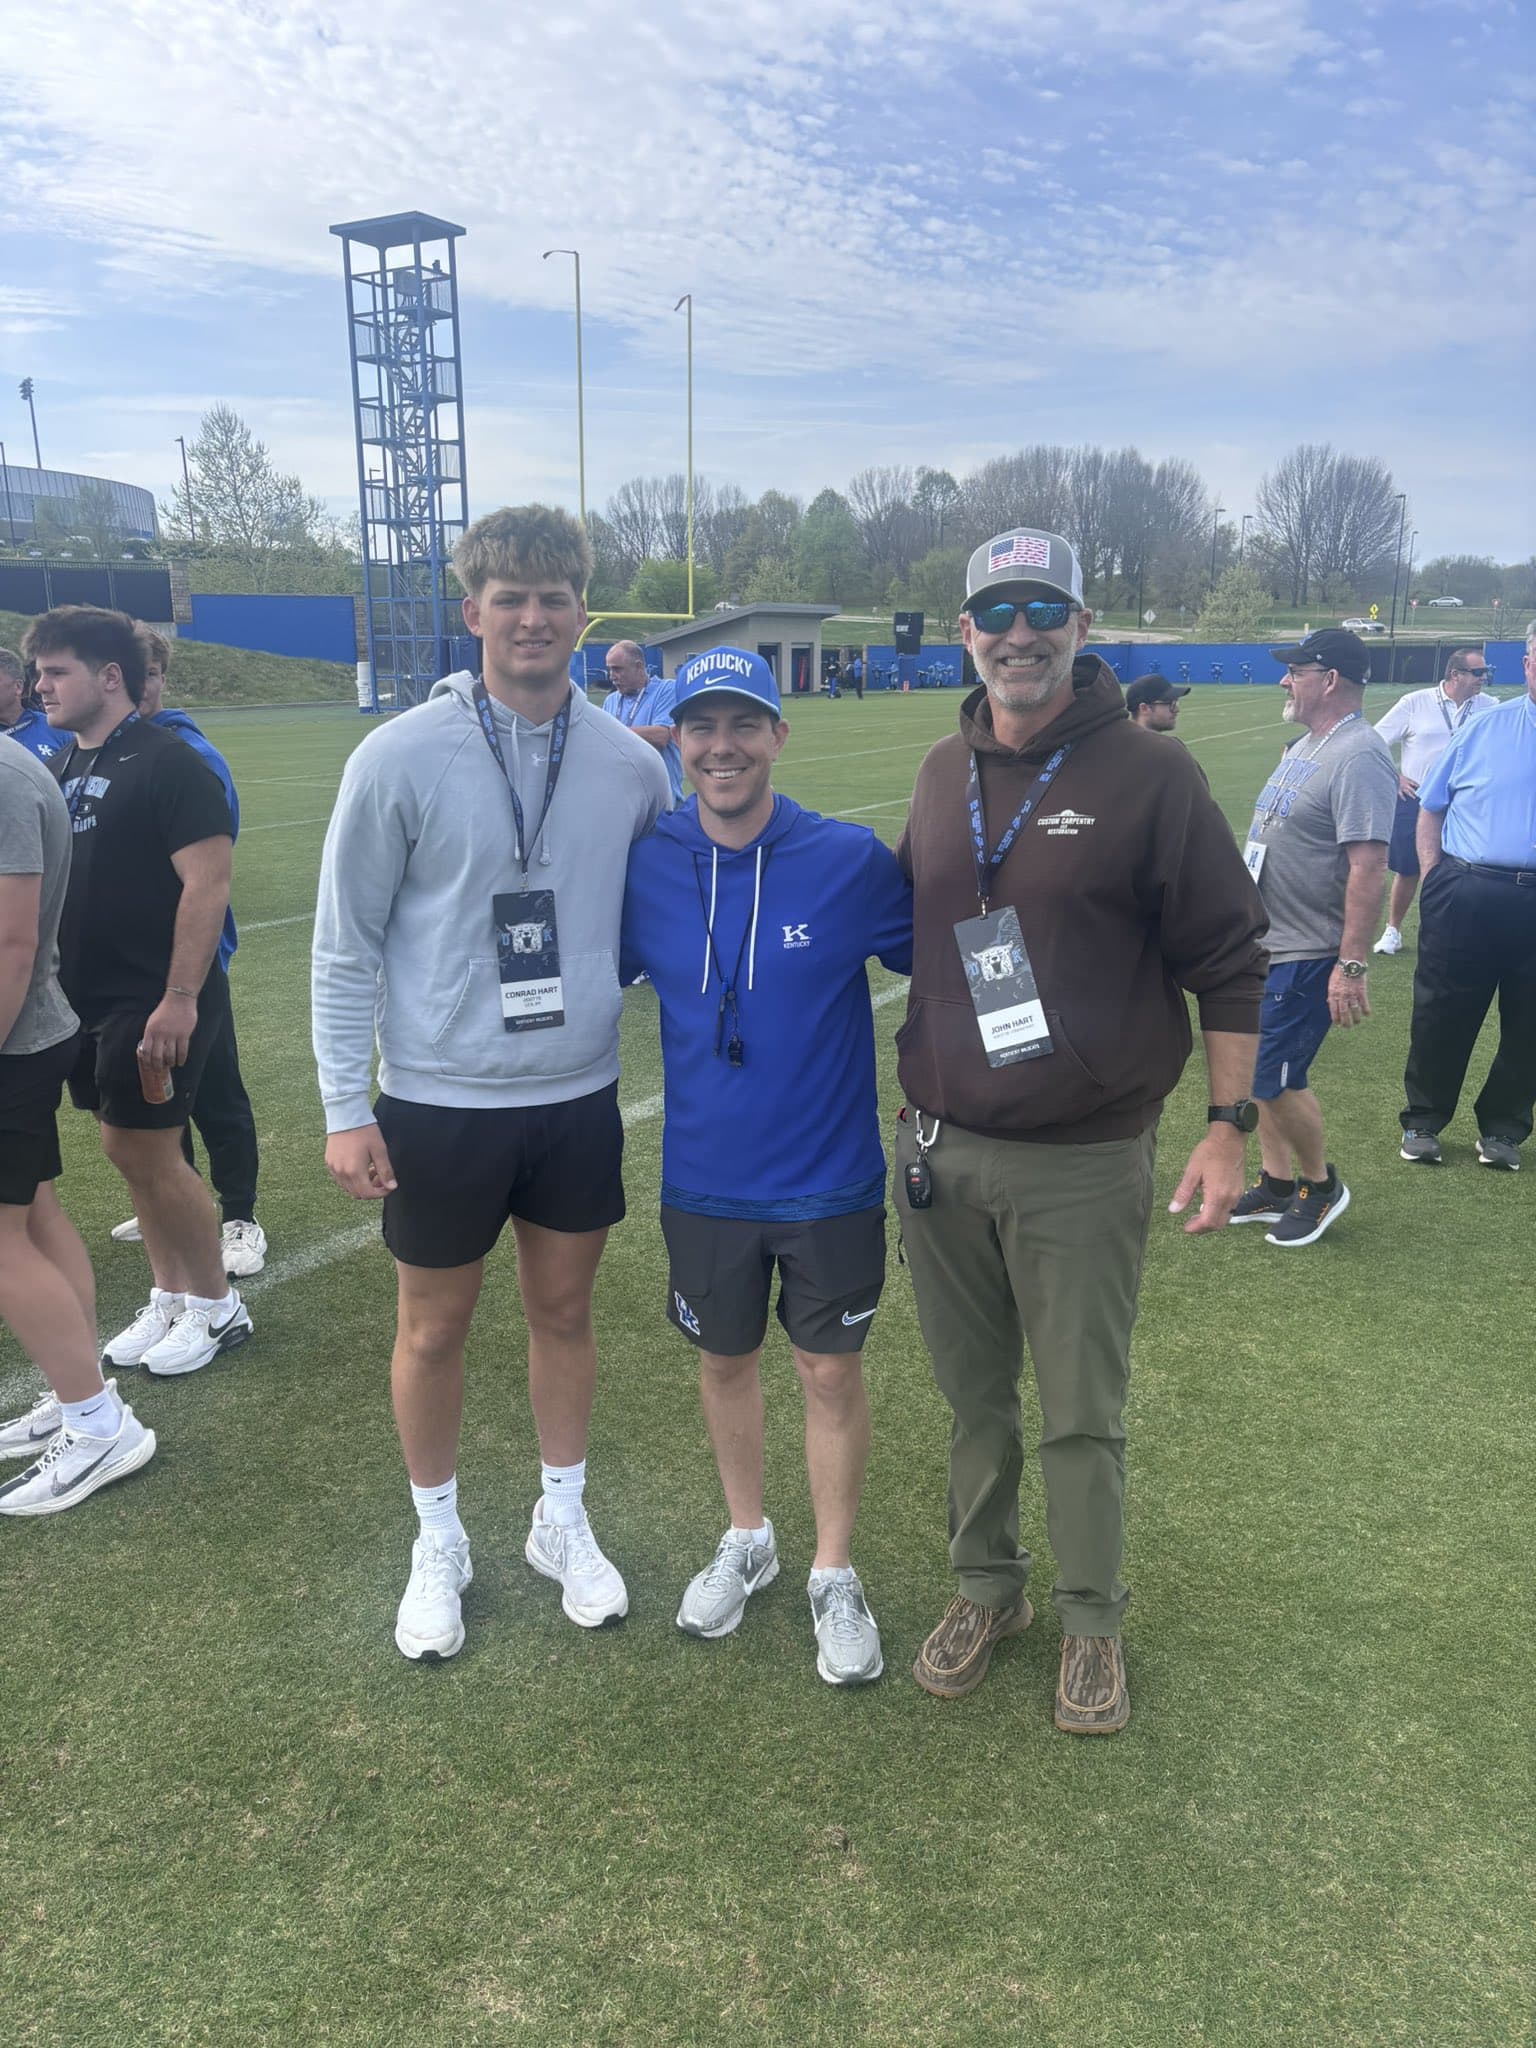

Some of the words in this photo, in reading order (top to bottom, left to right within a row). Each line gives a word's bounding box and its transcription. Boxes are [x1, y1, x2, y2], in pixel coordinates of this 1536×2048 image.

[686, 653, 753, 685] KENTUCKY
[1061, 817, 1096, 825] CARPENTRY
[782, 923, 811, 942] K
[505, 988, 537, 999] CONRAD
[537, 986, 558, 995] HART
[992, 1022, 1011, 1035] JOHN
[1012, 1015, 1032, 1028] HART
